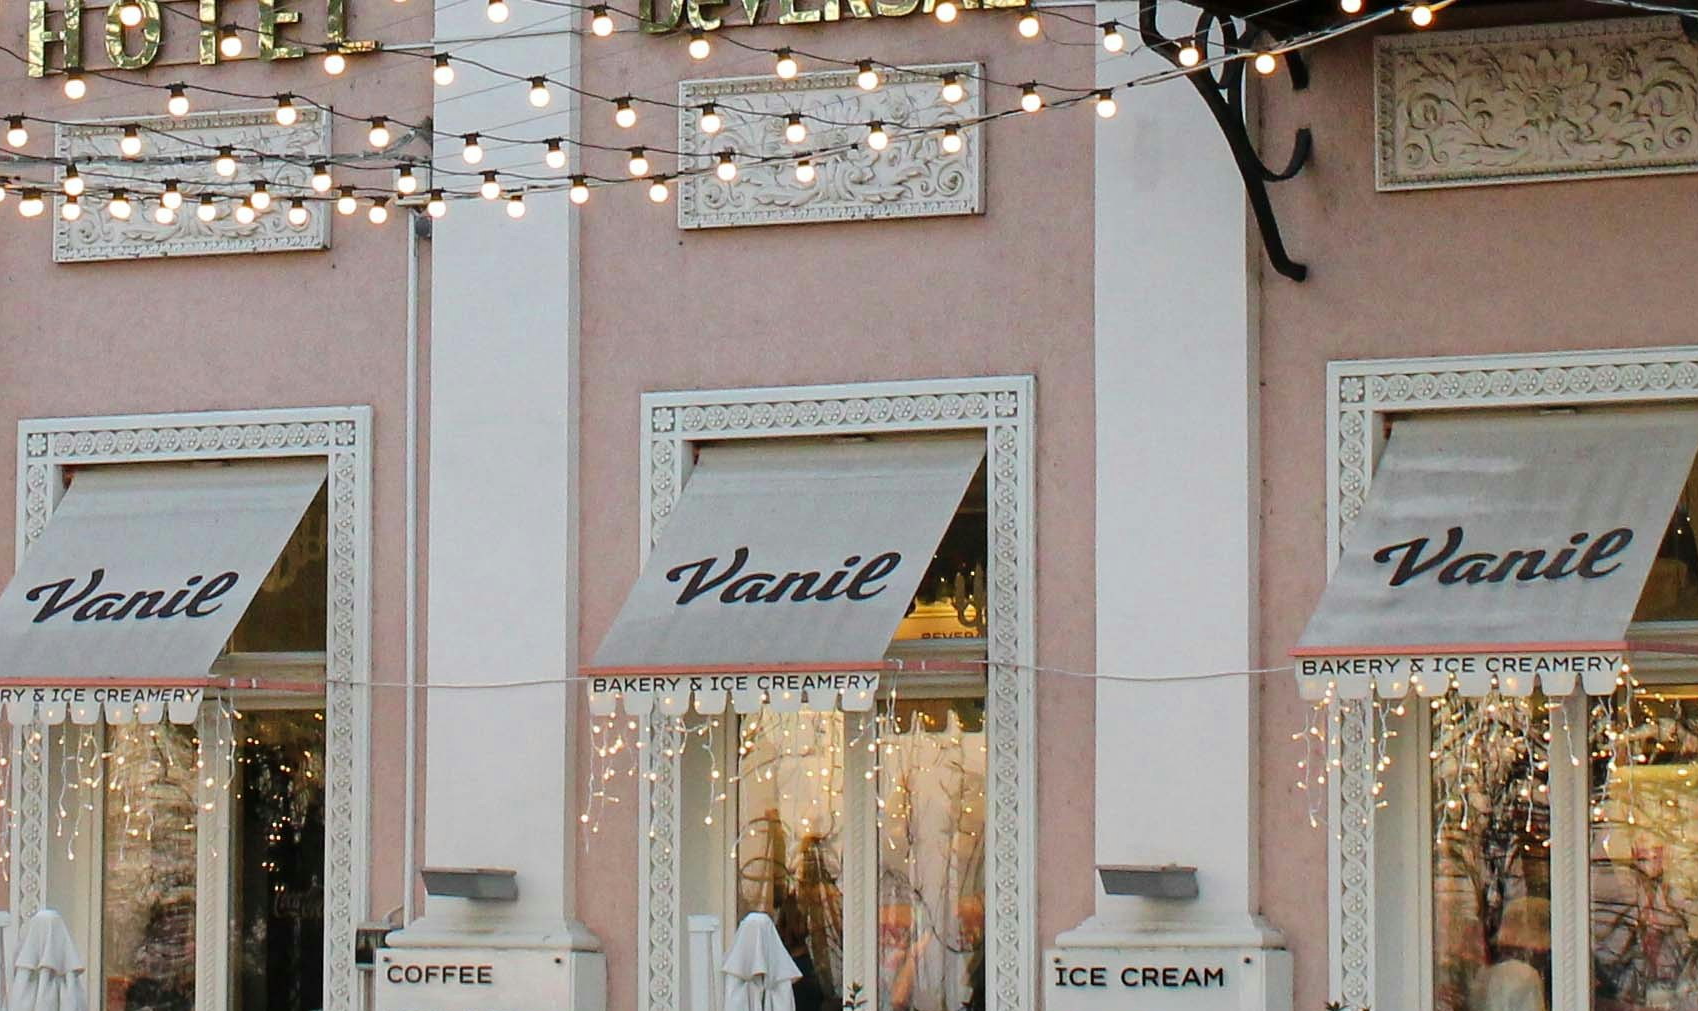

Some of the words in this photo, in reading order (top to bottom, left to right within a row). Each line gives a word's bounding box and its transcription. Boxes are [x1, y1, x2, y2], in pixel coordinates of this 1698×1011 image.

[1373, 526, 1634, 586] Vanil
[666, 547, 901, 605] Vanil
[26, 568, 239, 623] Vanil
[1302, 658, 1400, 675] BAKERY
[1410, 658, 1423, 672] &
[1433, 656, 1475, 673] ICE
[1486, 655, 1620, 674] CREAMERY
[593, 677, 680, 692] BAKERY
[690, 677, 702, 691] &
[711, 676, 748, 691] ICE
[757, 674, 877, 690] CREAMERY
[33, 688, 44, 702] &
[52, 688, 86, 702] ICE
[94, 688, 199, 702] CREAMERY
[387, 965, 493, 984] COFFEE
[1055, 967, 1107, 987] ICE
[1121, 967, 1224, 987] CREAM
